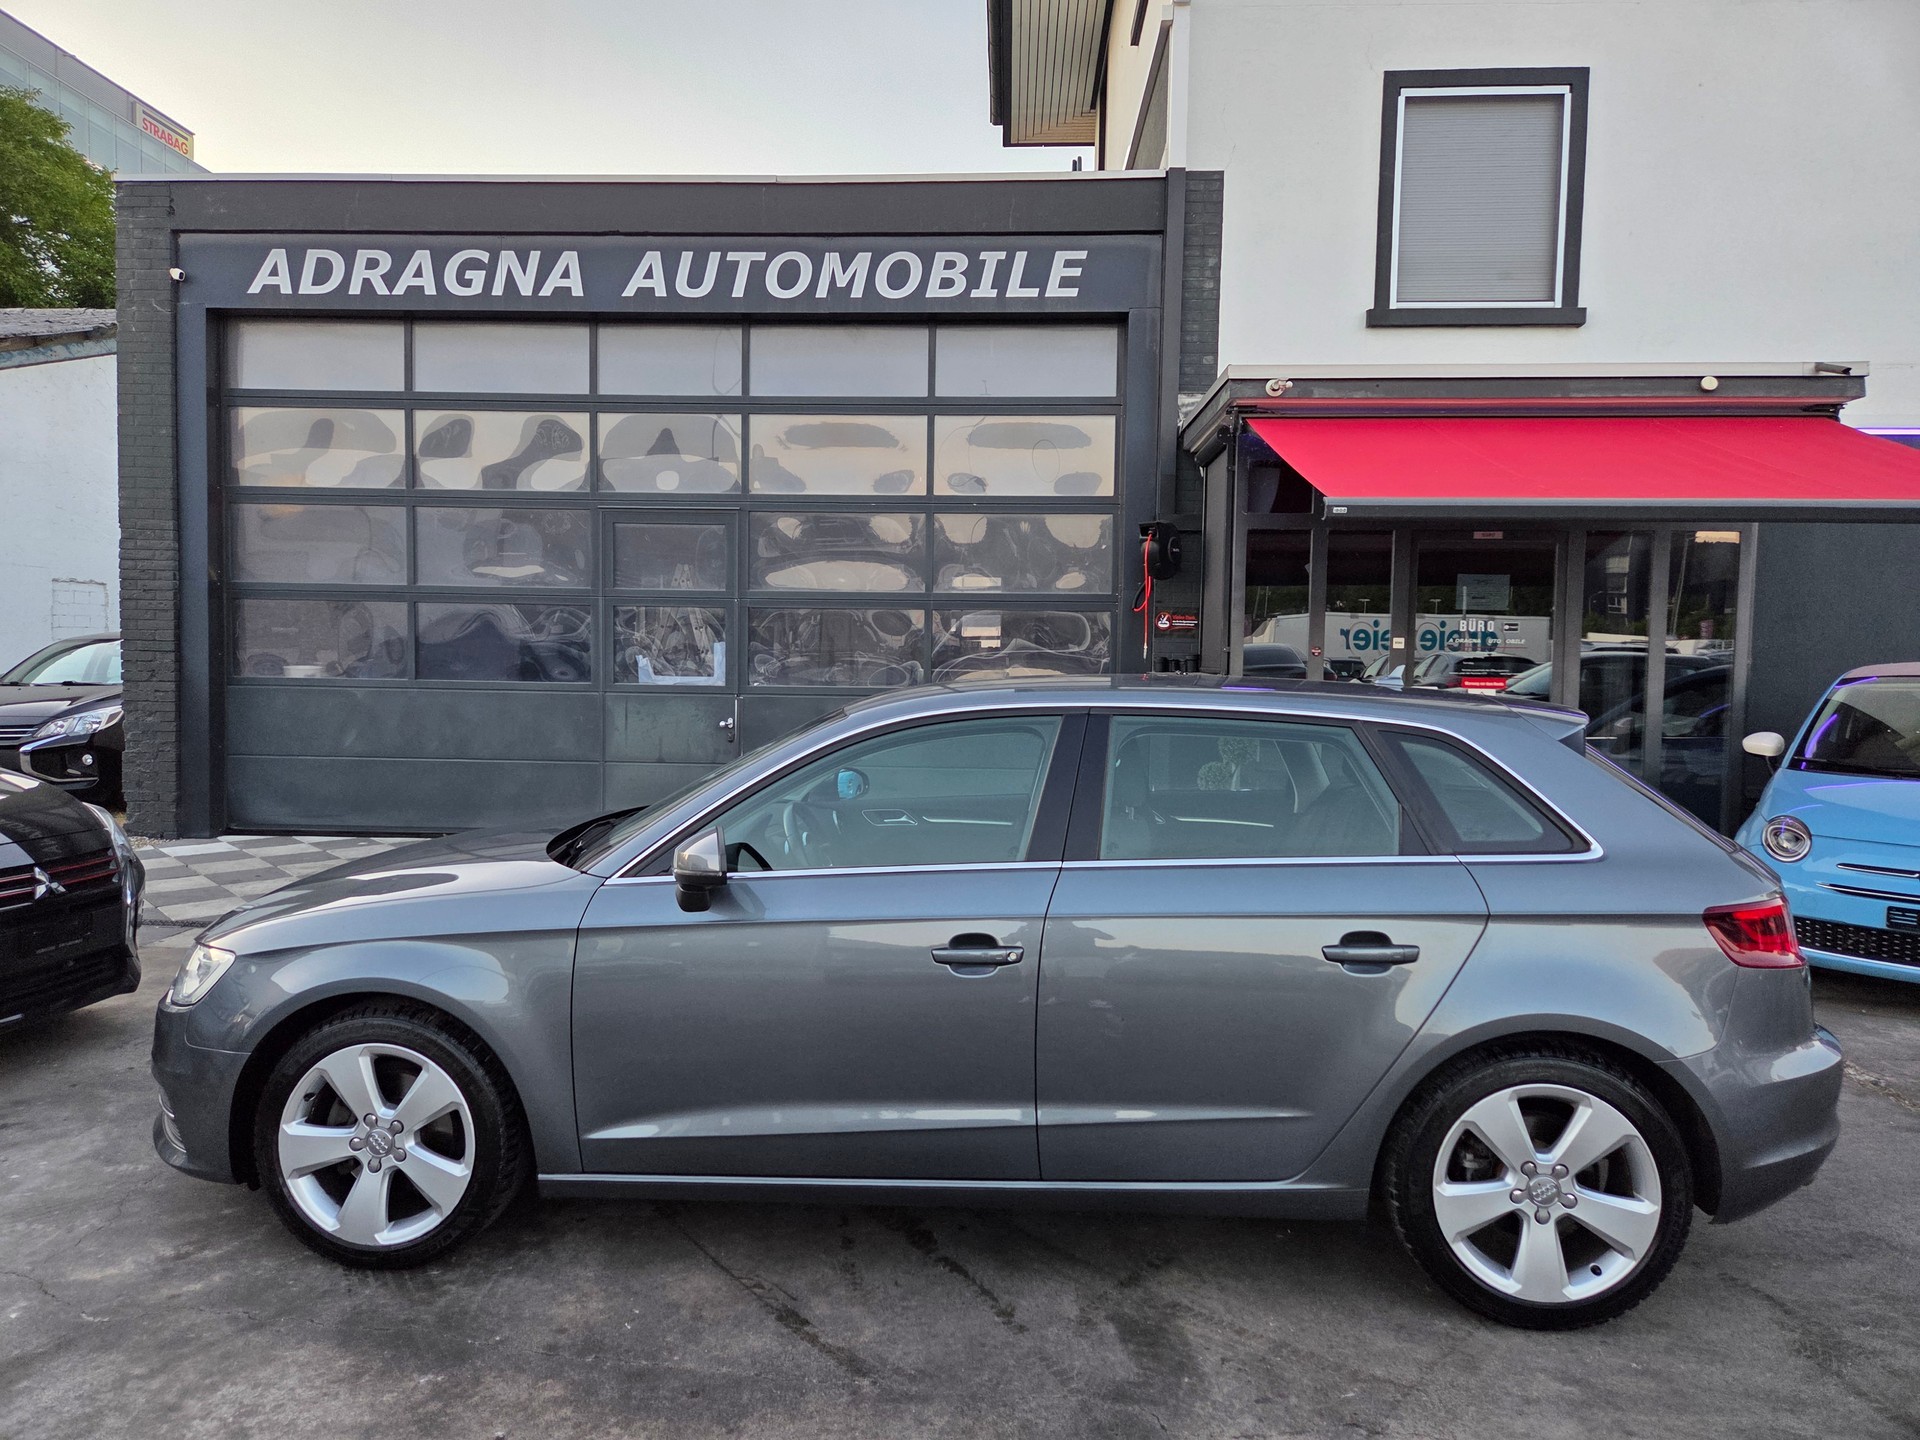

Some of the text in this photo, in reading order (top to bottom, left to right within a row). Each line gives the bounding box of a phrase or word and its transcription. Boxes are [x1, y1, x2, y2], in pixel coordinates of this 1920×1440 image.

[142, 117, 189, 155] STRABAG
[246, 248, 1088, 299] ADRAGNA AUTOMOBILE
[1459, 619, 1495, 632] BÜRO
